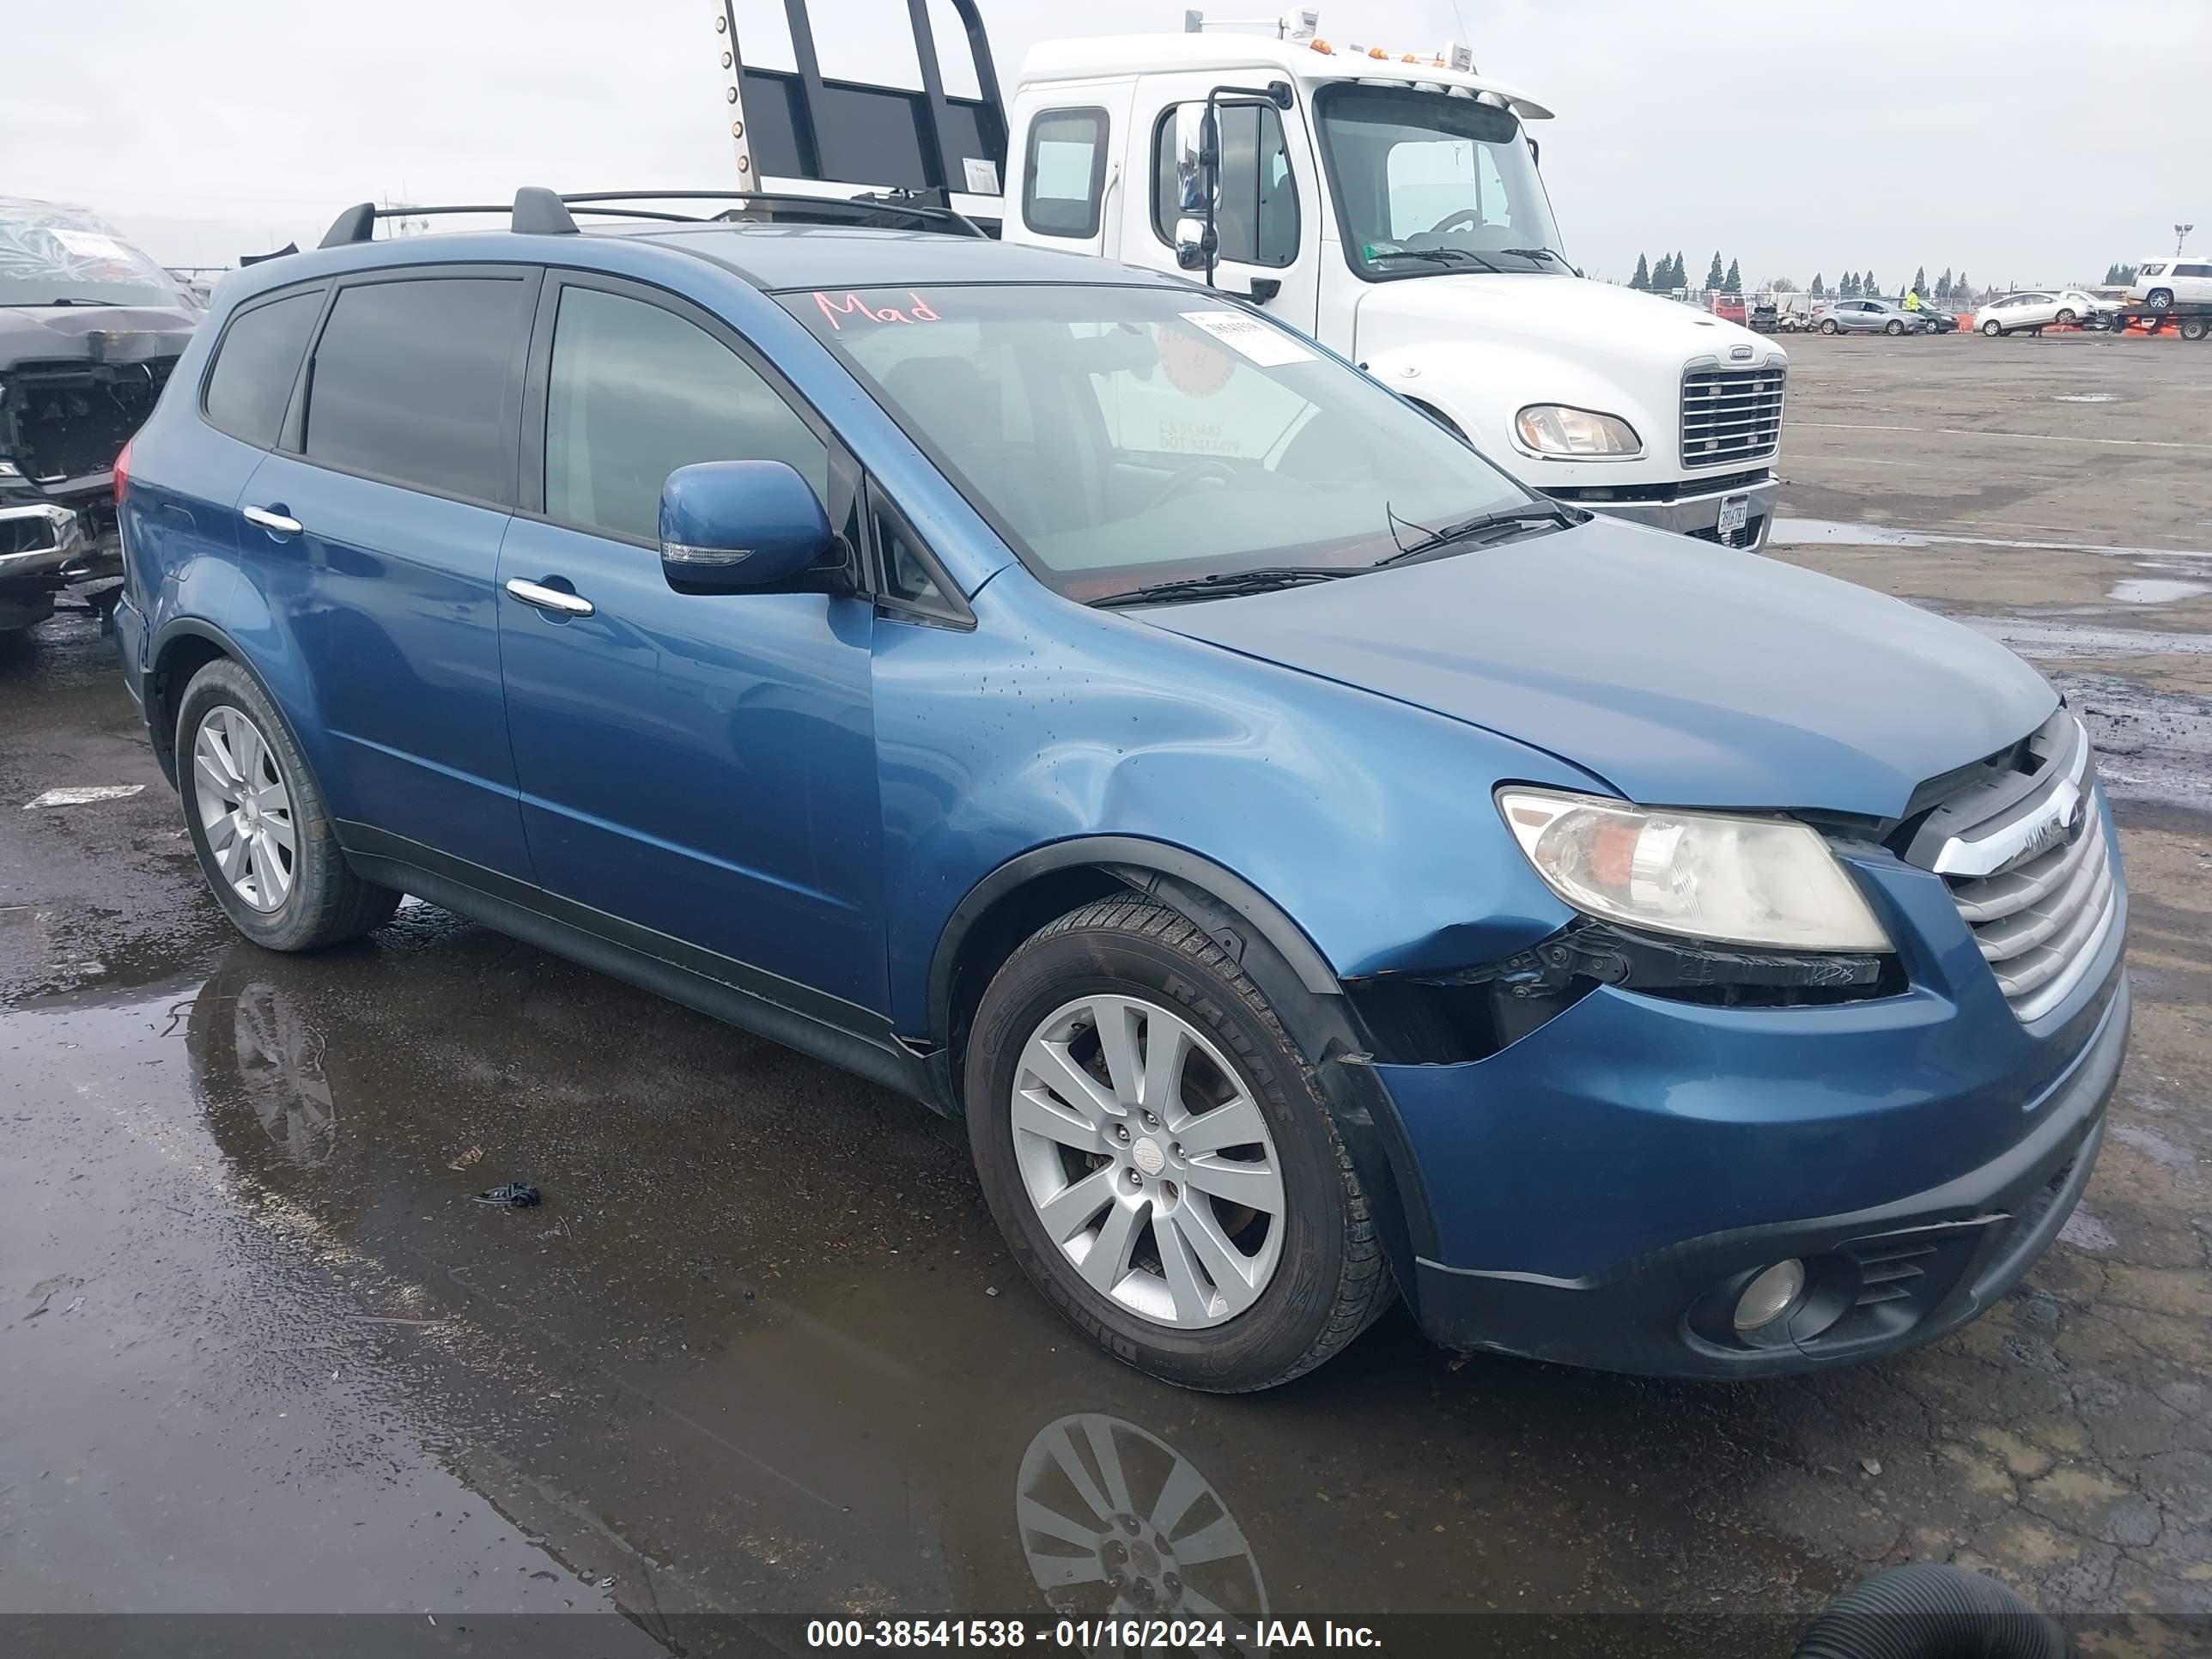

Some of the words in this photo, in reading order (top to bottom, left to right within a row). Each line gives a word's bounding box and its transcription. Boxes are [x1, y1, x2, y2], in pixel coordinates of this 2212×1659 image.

[813, 292, 941, 330] Mad
[1160, 436, 1187, 450] DOT
[1163, 974, 1296, 1121] RADAR
